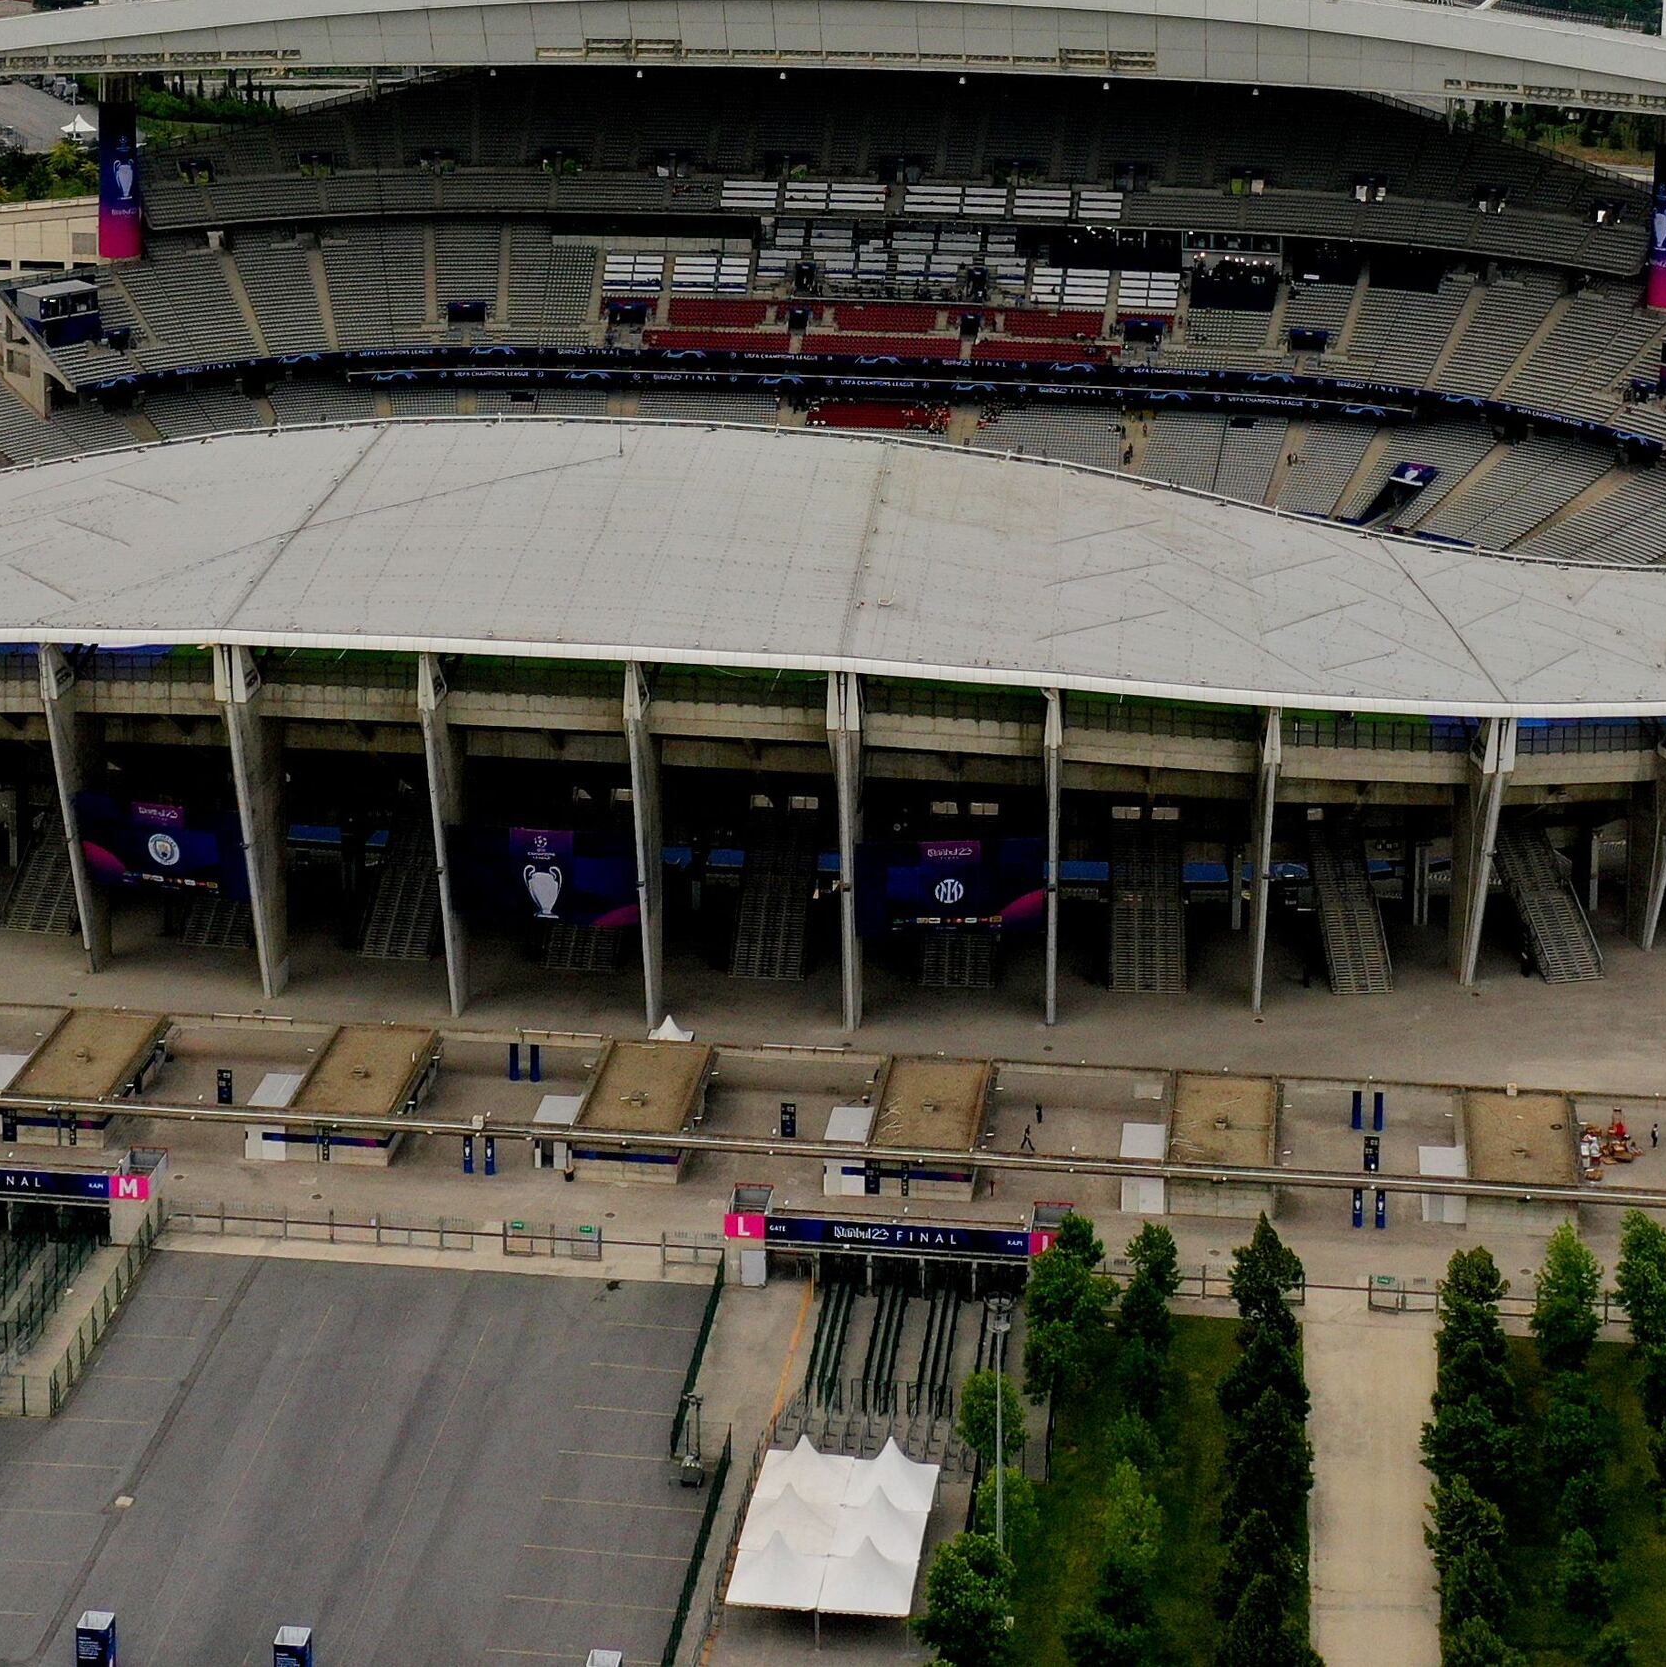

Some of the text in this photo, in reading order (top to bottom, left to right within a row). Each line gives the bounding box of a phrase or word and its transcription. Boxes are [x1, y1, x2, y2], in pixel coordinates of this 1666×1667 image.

[118, 1177, 138, 1198] M
[737, 1216, 750, 1237] L
[896, 1231, 957, 1245] FINAL
